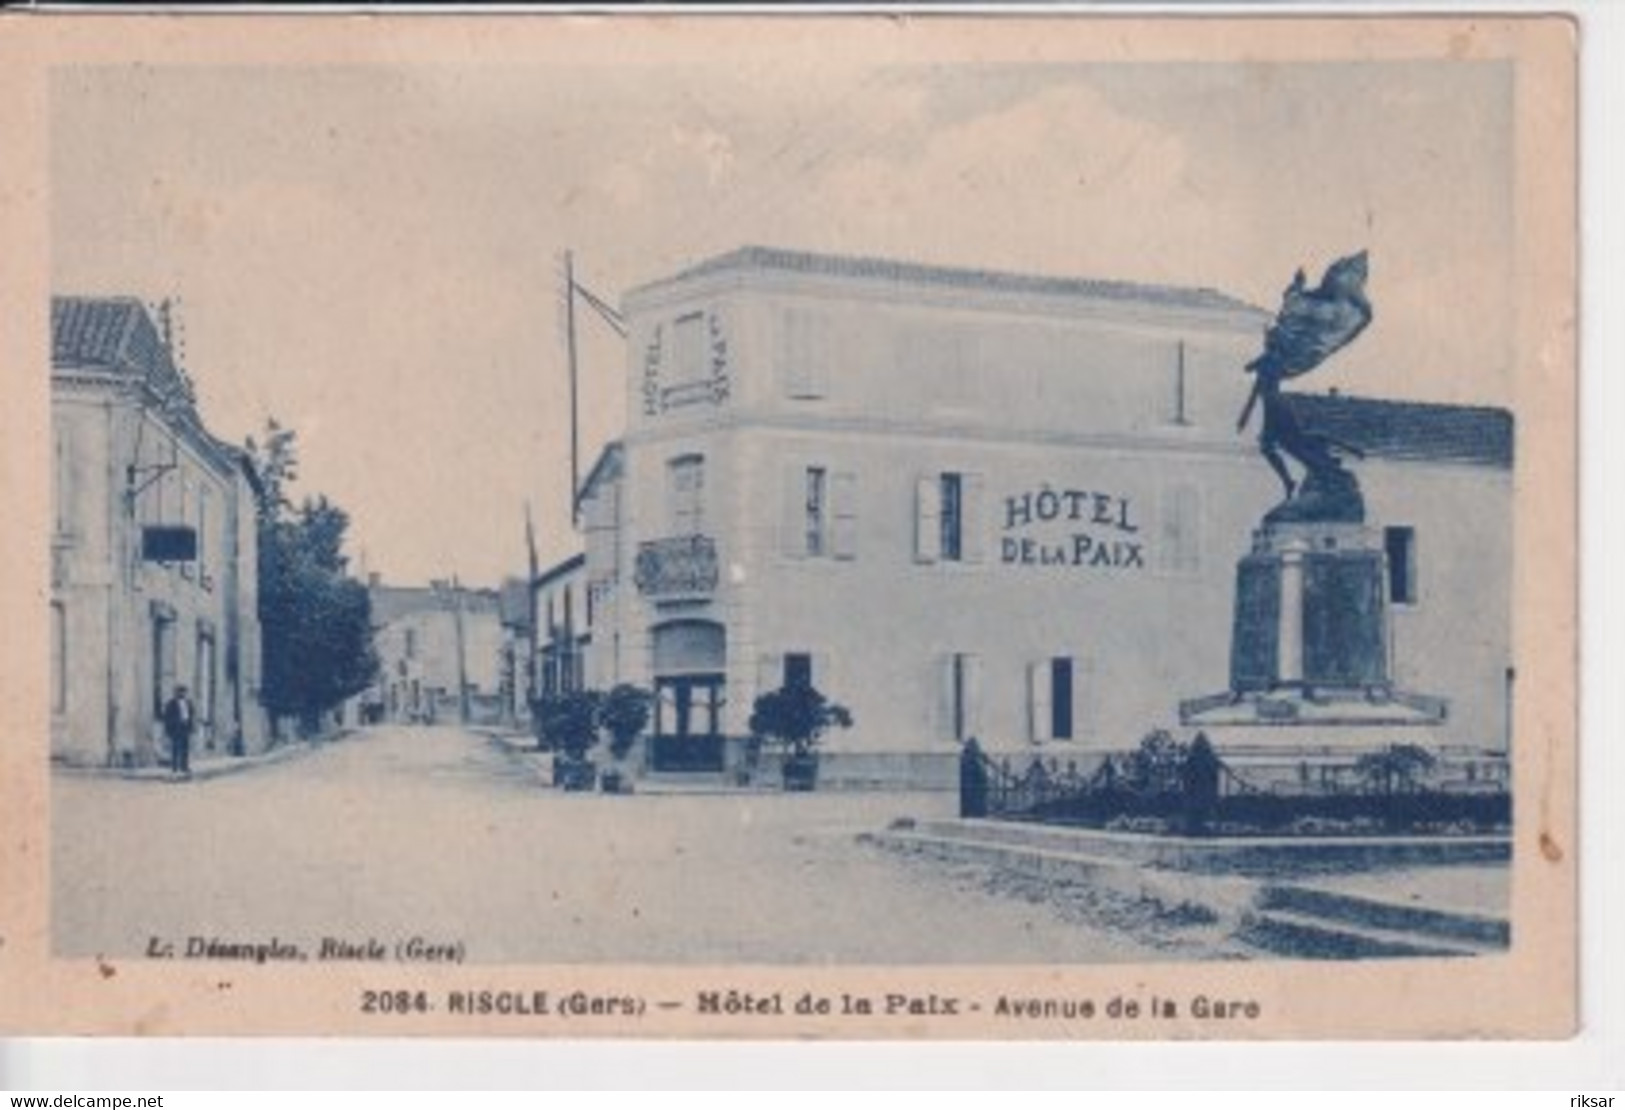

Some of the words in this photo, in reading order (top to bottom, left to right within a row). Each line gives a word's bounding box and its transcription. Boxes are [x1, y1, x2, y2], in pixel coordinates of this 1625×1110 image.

[1001, 536, 1036, 566] DE
[1041, 545, 1066, 566] LA
[1070, 533, 1144, 568] PAIX
